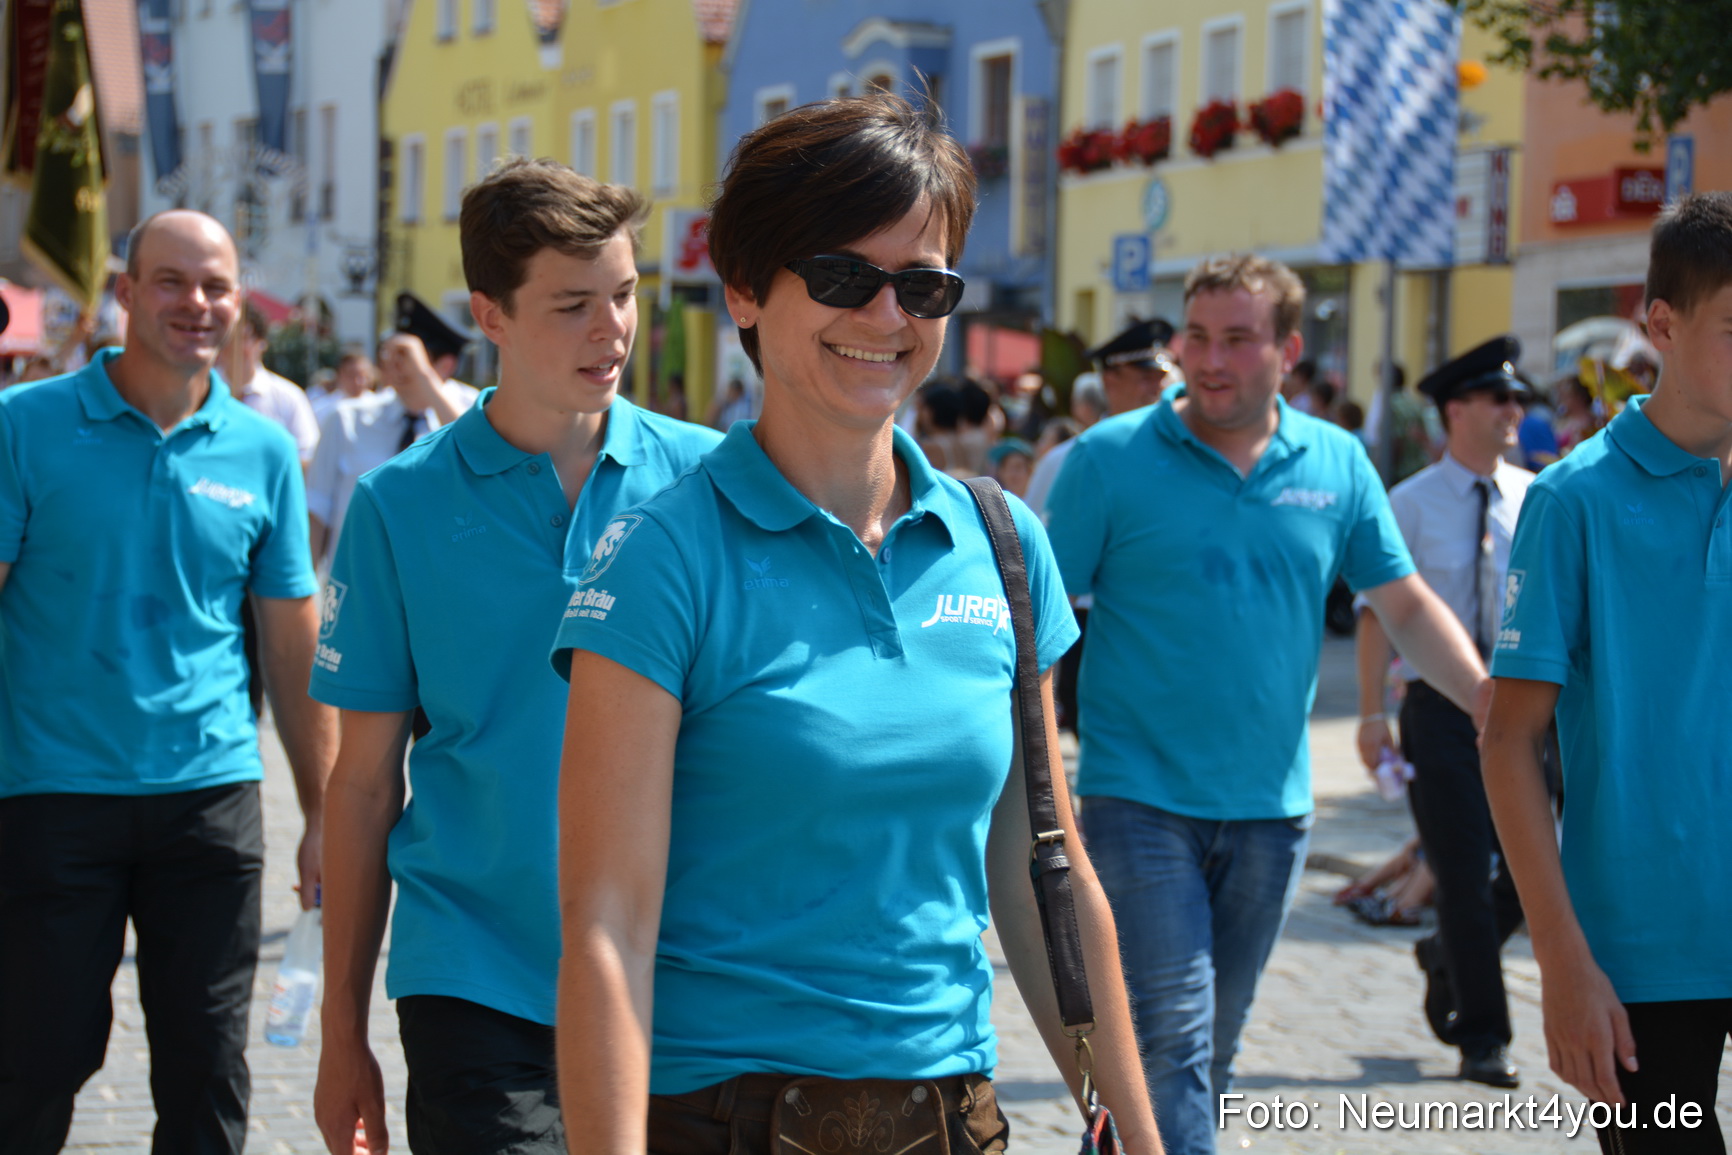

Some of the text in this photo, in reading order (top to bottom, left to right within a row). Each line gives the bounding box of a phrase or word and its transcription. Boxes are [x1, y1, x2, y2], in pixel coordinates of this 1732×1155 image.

[744, 577, 789, 590] erima
[583, 588, 616, 611] Bräu
[969, 616, 994, 627] SERVICE
